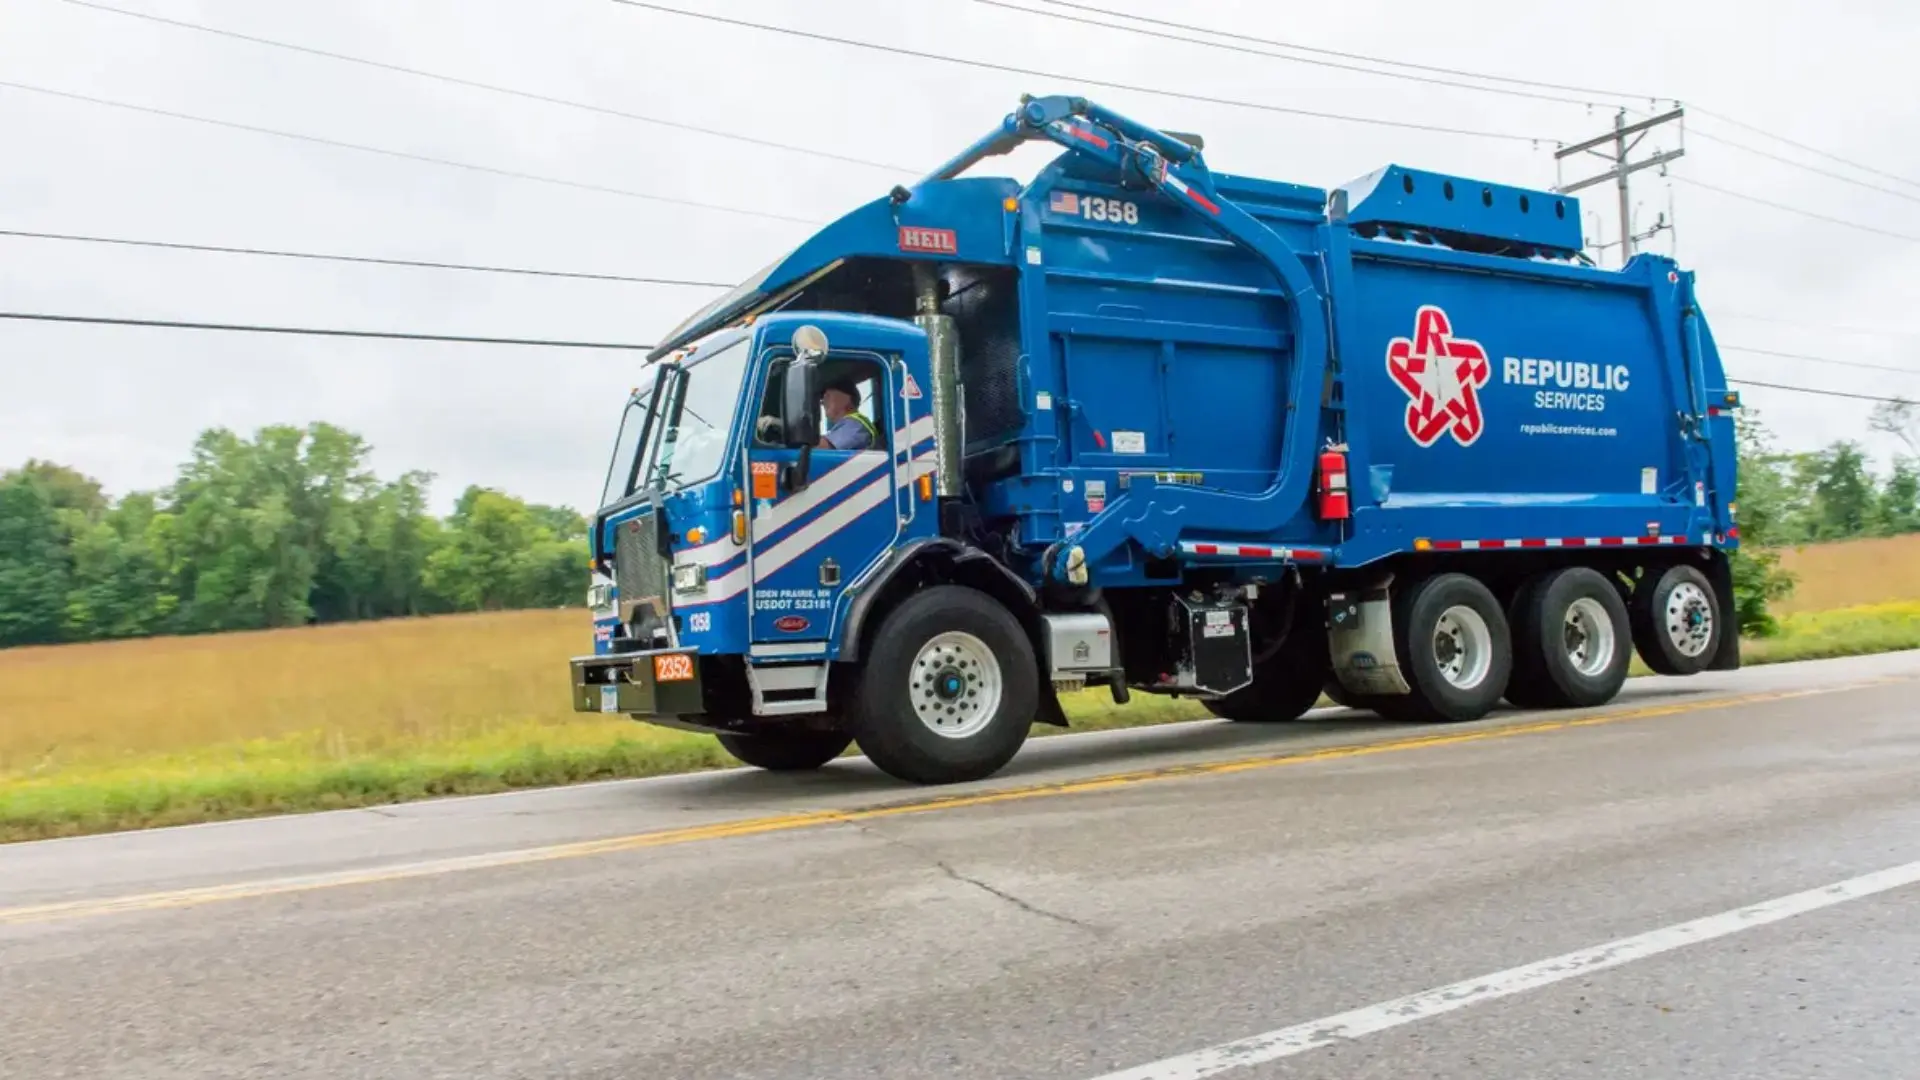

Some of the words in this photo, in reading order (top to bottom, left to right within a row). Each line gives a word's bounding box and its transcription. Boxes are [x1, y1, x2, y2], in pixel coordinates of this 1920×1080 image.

[1081, 197, 1139, 225] 1358
[904, 229, 953, 250] HEIL
[1503, 356, 1630, 392] REPUBLIC
[1534, 390, 1605, 411] SERVICES
[1520, 423, 1617, 436] republicservices.com
[755, 589, 778, 598] EDEN
[755, 599, 792, 609] USDOT
[660, 657, 693, 680] 2352
